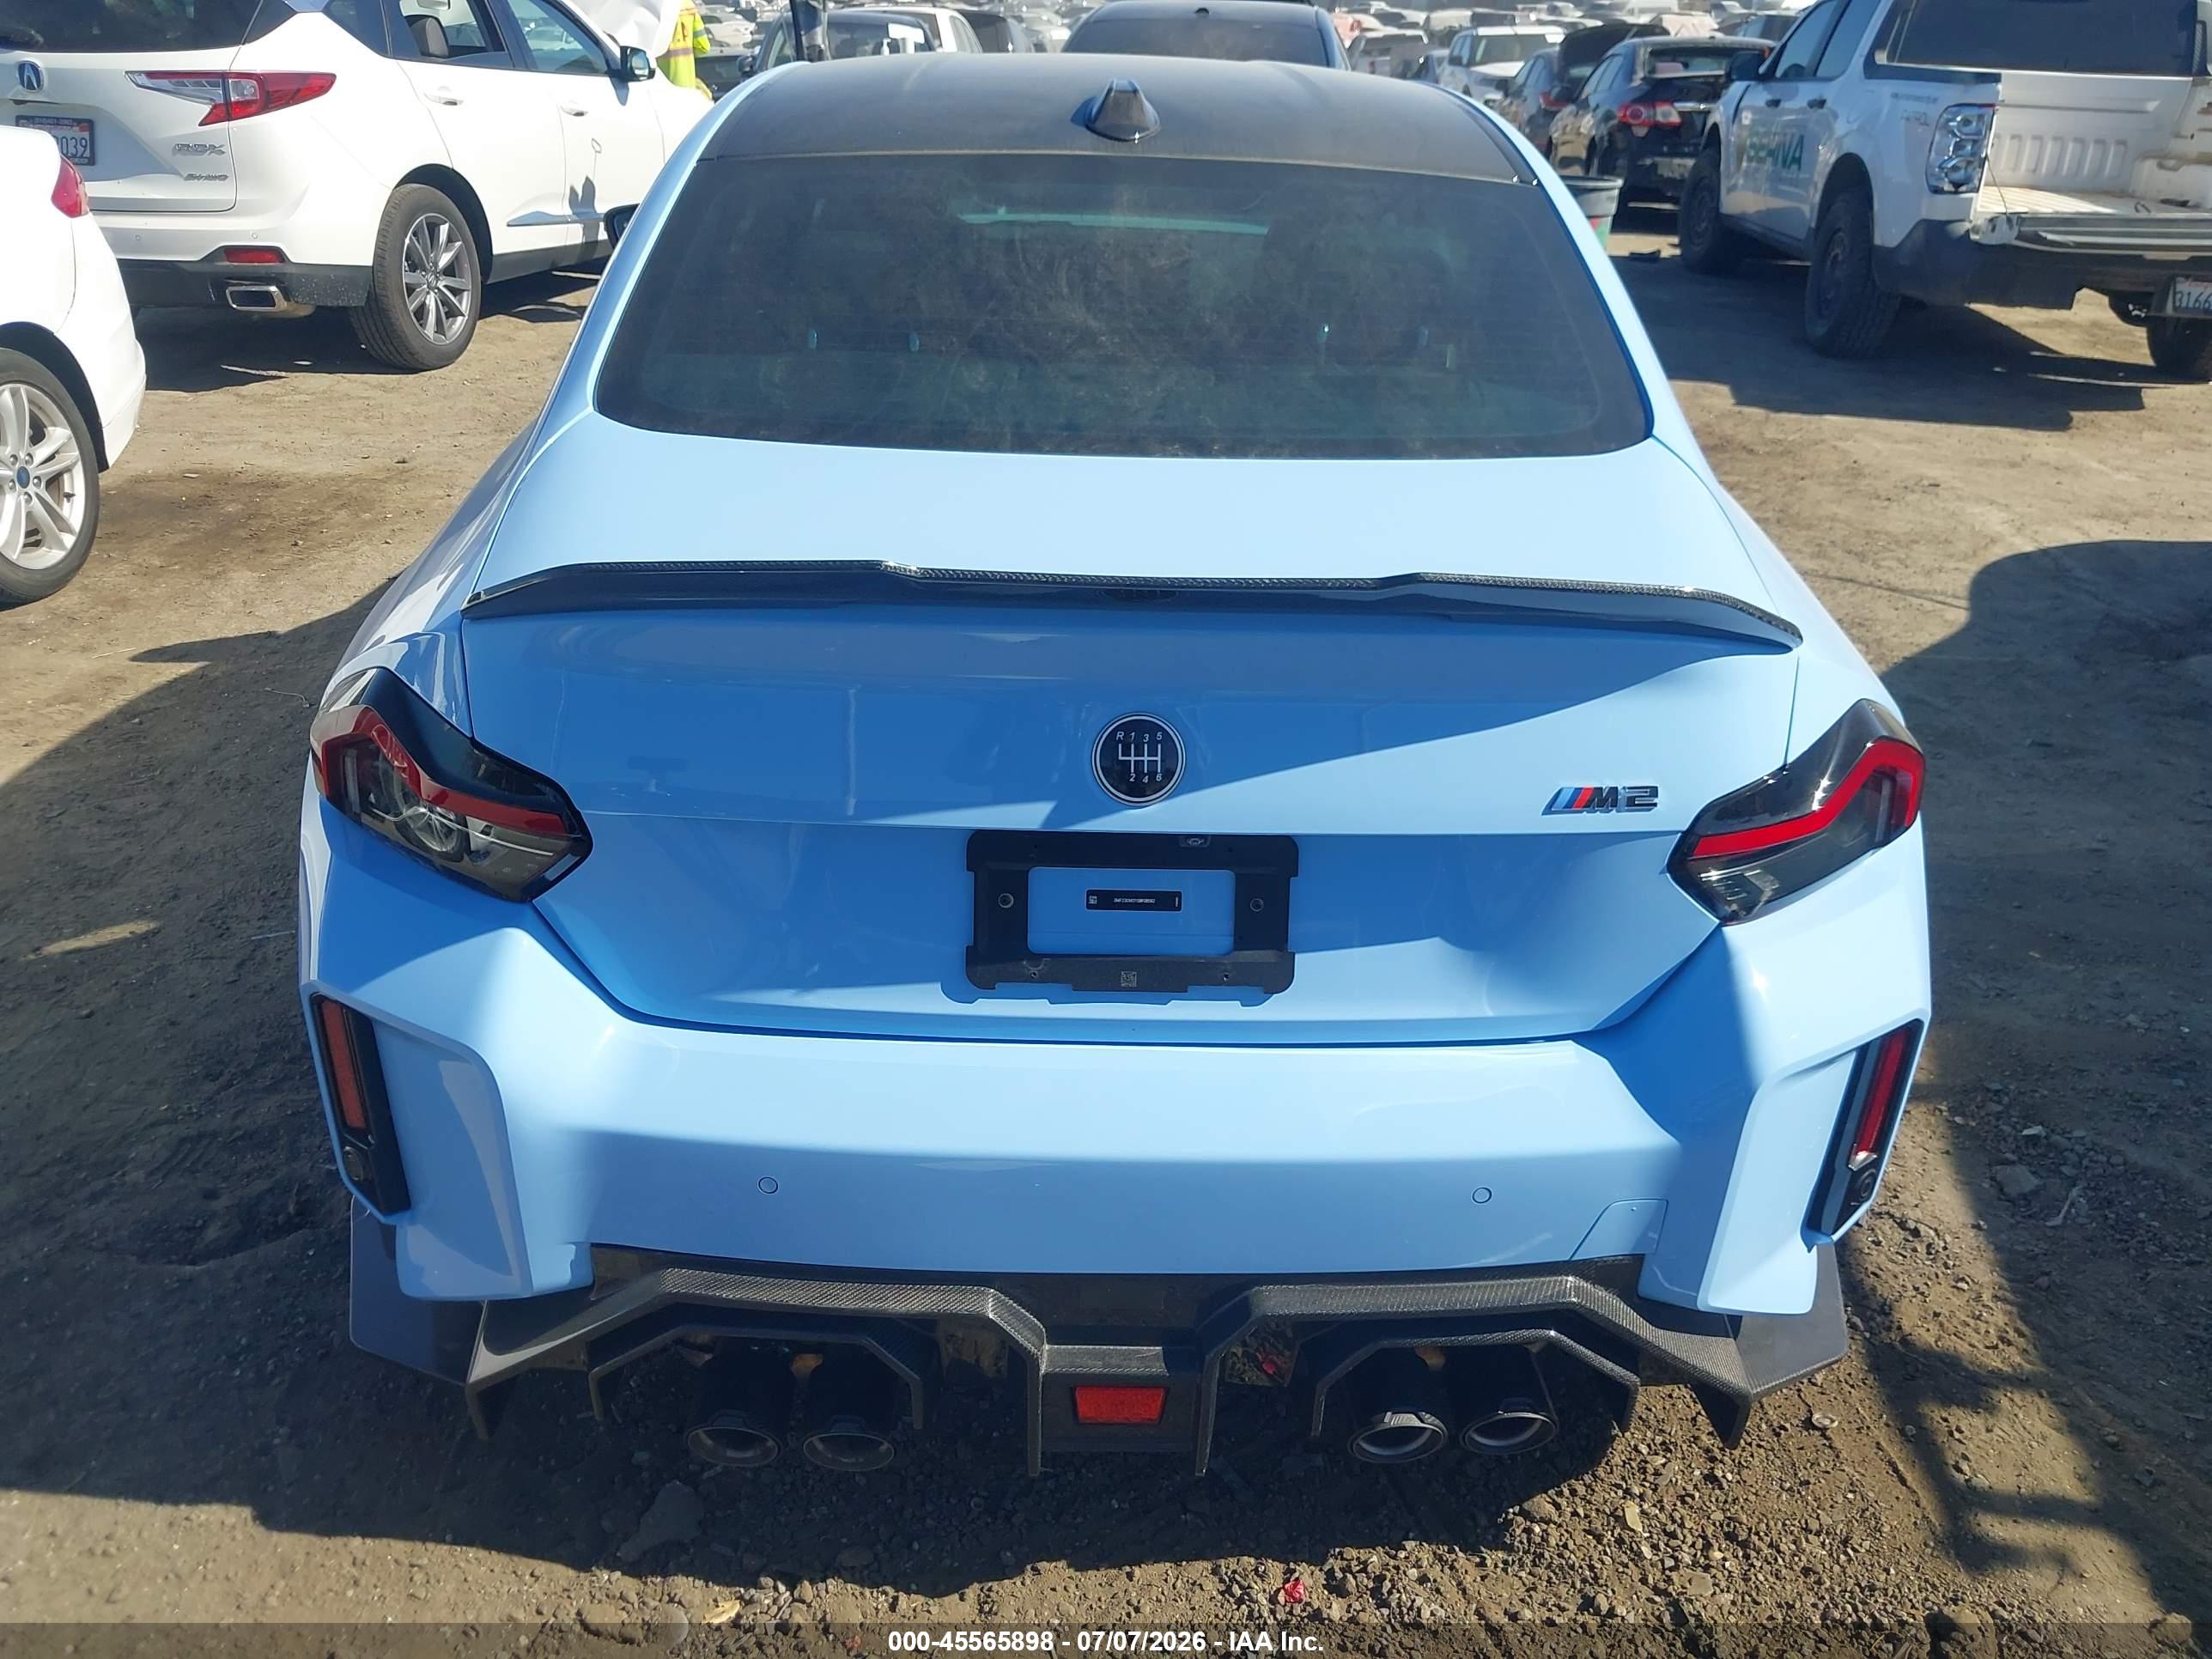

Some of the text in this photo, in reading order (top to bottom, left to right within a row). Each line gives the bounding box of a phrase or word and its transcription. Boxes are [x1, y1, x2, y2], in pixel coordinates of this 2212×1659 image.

[53, 136, 88, 158] 039
[1116, 731, 1163, 743] R 1 3 5
[1129, 773, 1163, 784] 2 4 6
